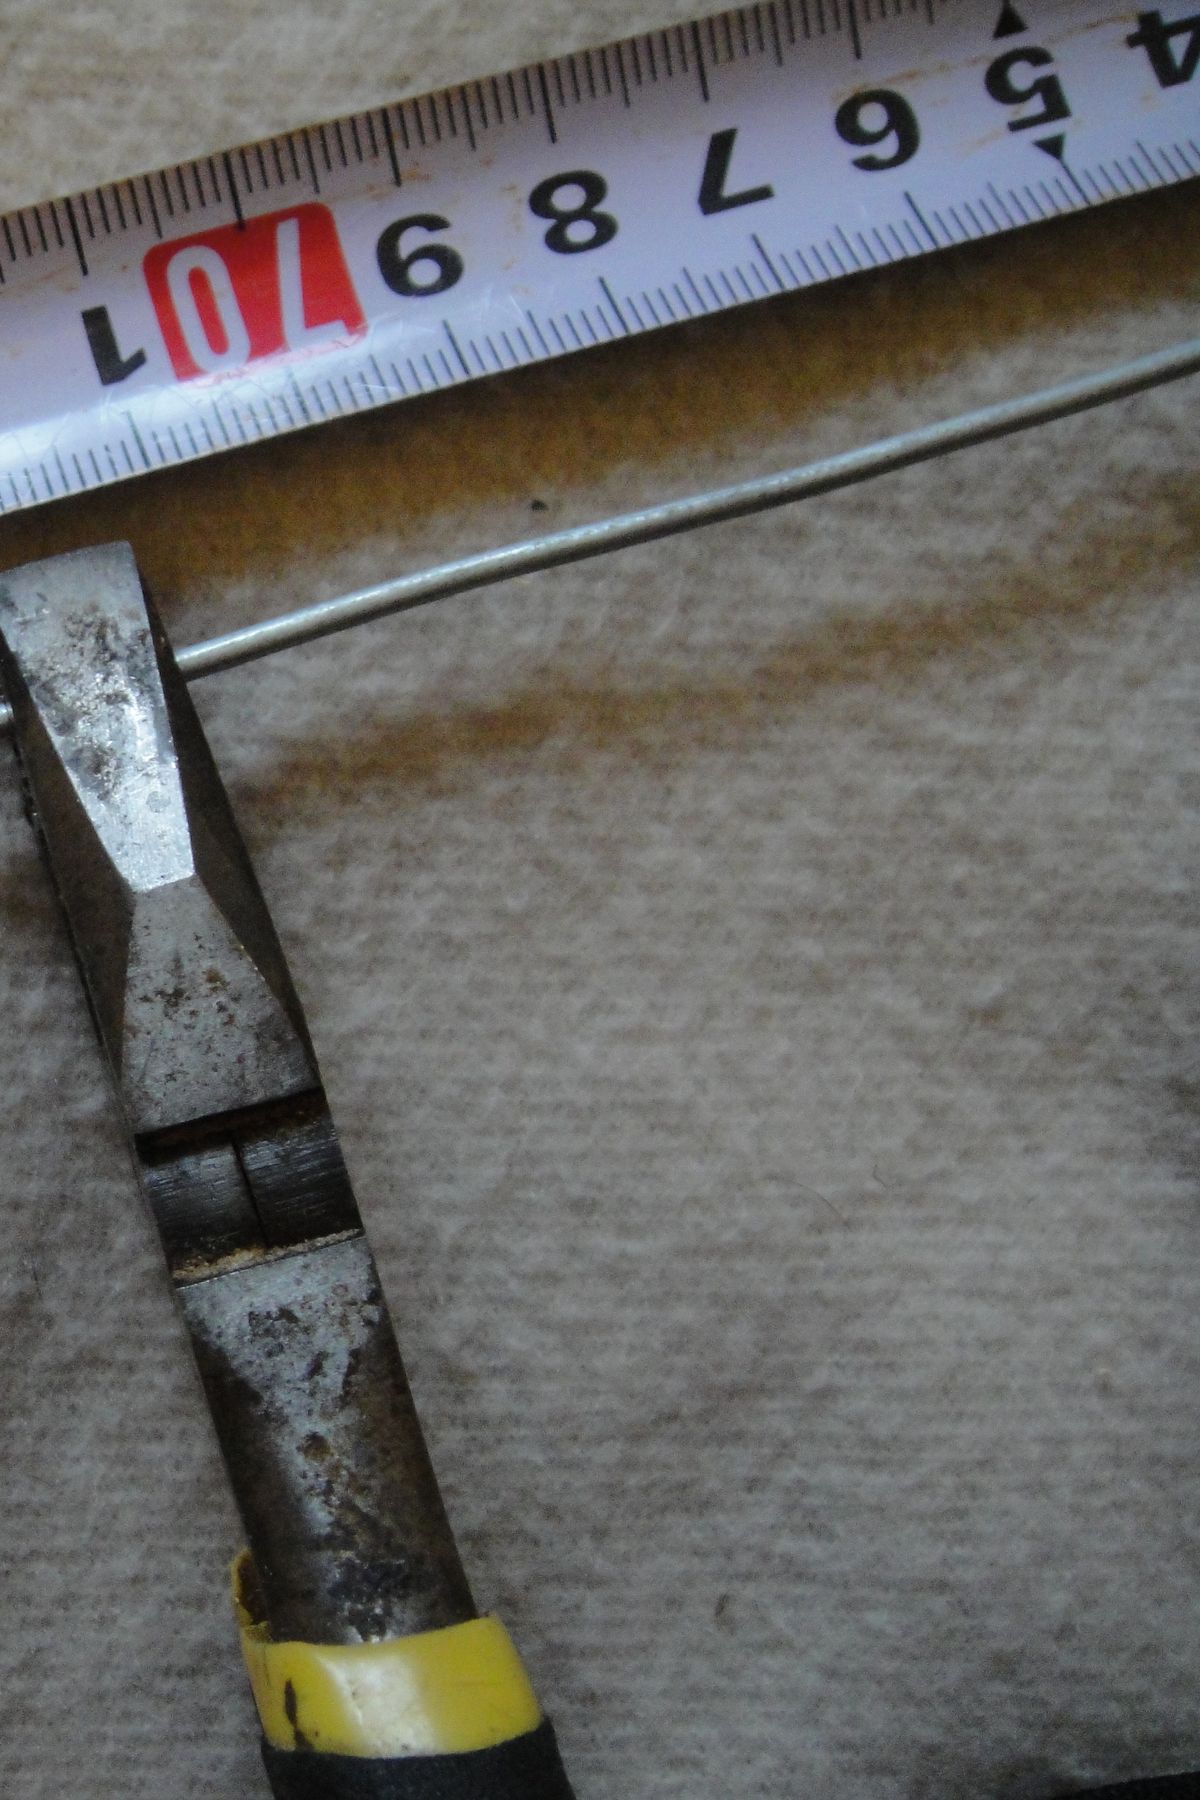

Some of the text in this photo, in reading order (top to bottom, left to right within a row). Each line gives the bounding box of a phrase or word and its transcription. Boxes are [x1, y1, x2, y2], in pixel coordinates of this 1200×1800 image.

[983, 45, 1072, 133] 5
[1125, 9, 1200, 88] 4
[698, 127, 775, 216] 7
[833, 87, 920, 172] 6
[527, 169, 618, 255] 8
[167, 217, 351, 373] 70
[375, 213, 463, 298] 9
[80, 305, 147, 386] 1
